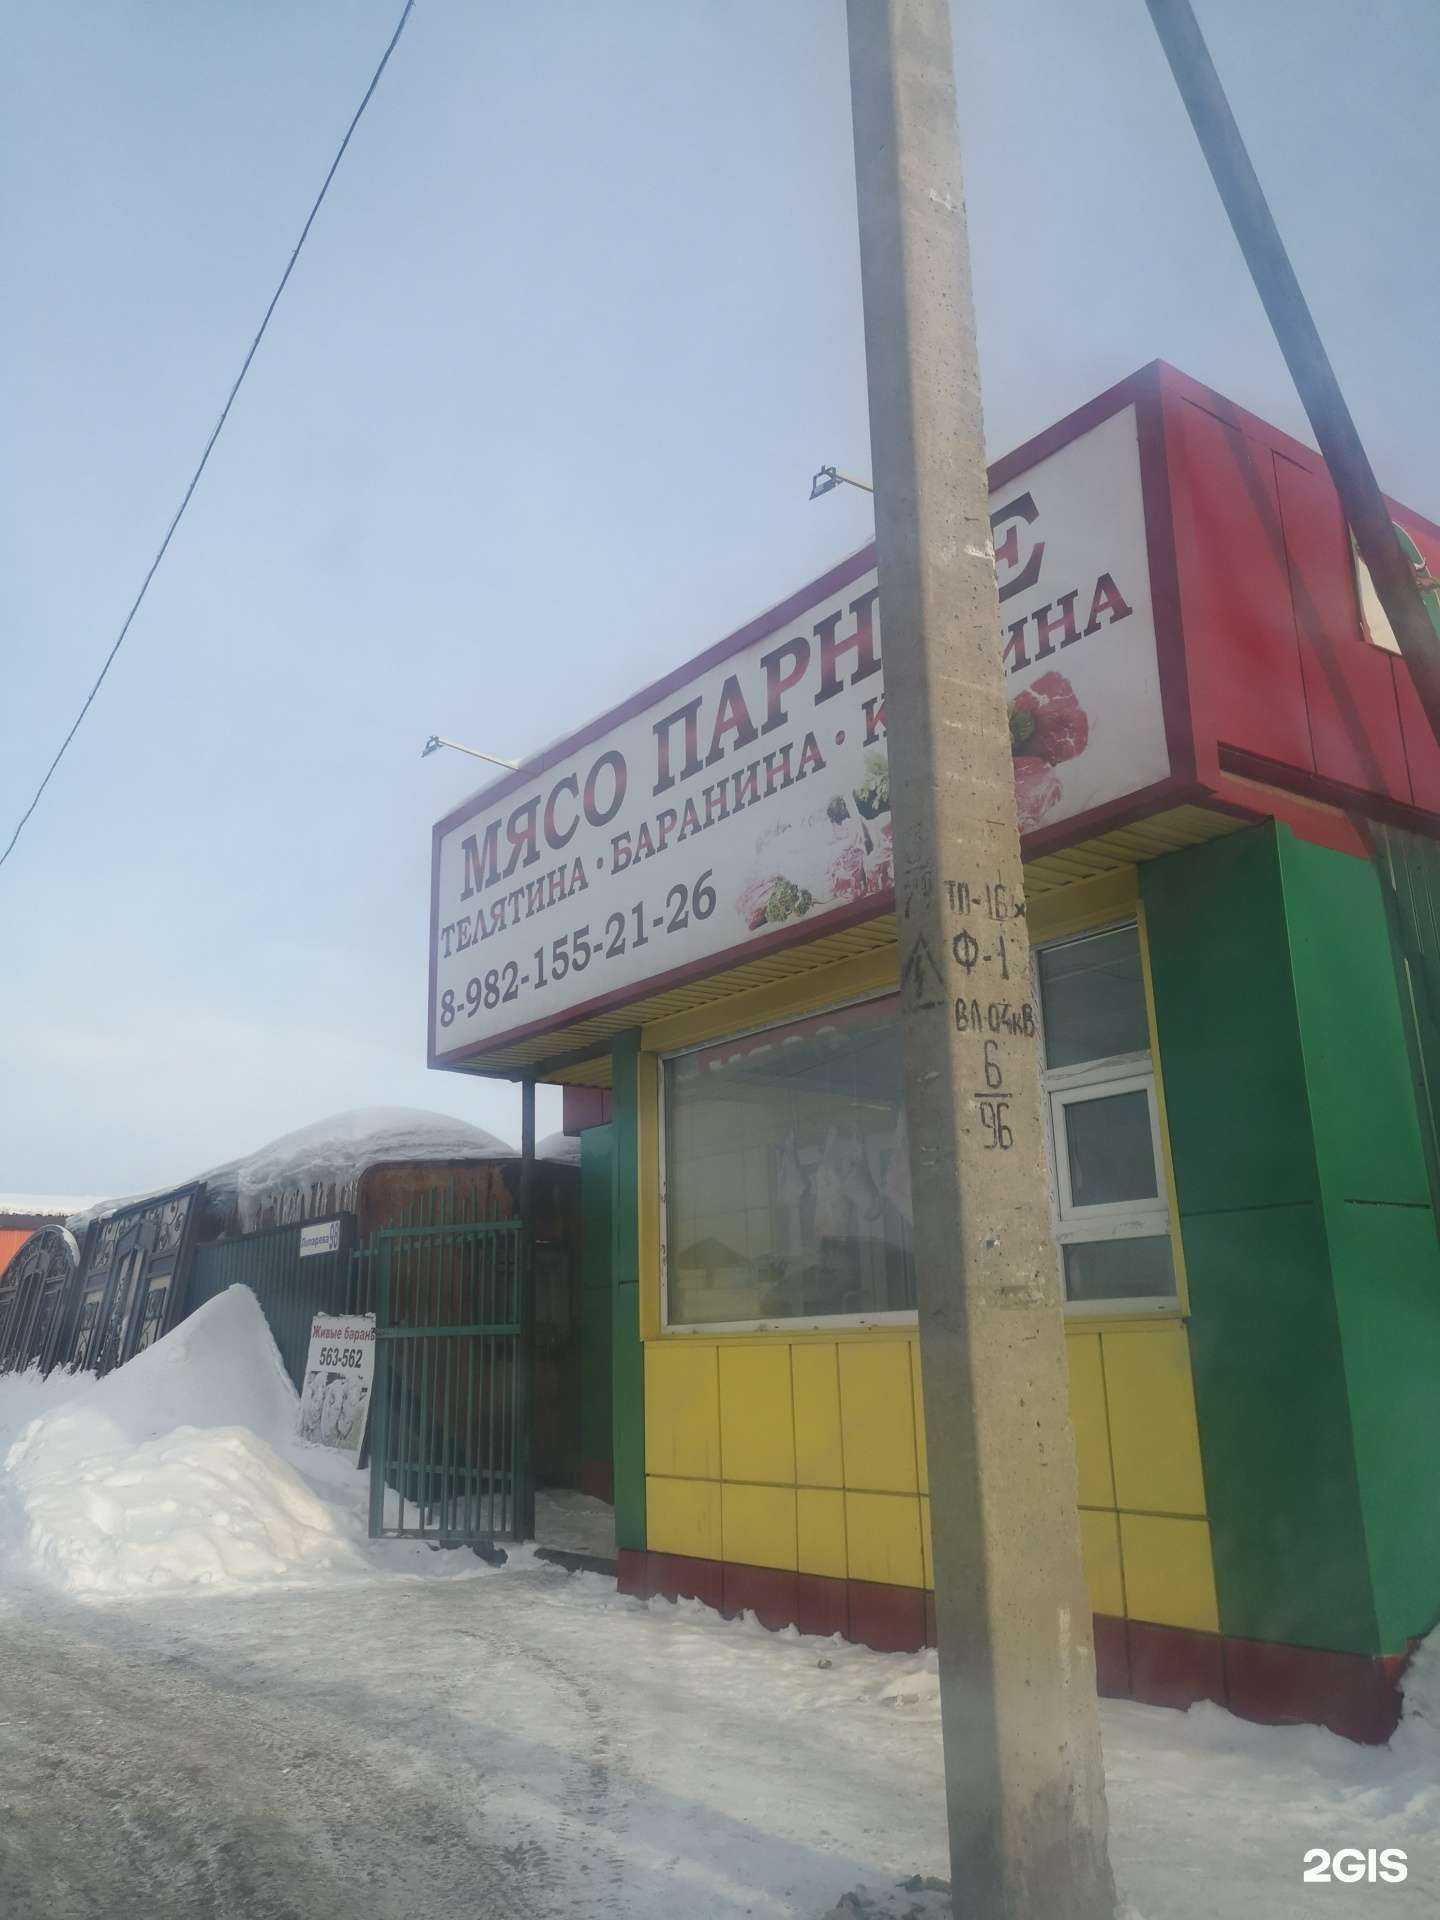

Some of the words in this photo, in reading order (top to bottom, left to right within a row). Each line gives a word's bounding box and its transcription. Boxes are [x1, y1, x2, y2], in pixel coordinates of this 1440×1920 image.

[460, 749, 628, 902] МЯСО
[652, 490, 1046, 797] ПАРНЕ
[441, 855, 589, 959] ТЕЛЯТИНА
[610, 730, 827, 876] БАРАНИНА
[861, 571, 1133, 749] КИНА
[440, 868, 717, 1028] 8-982-155-21-26
[980, 1102, 1014, 1150] 96
[313, 1325, 342, 1340] Живые
[319, 1347, 363, 1369] 563-562
